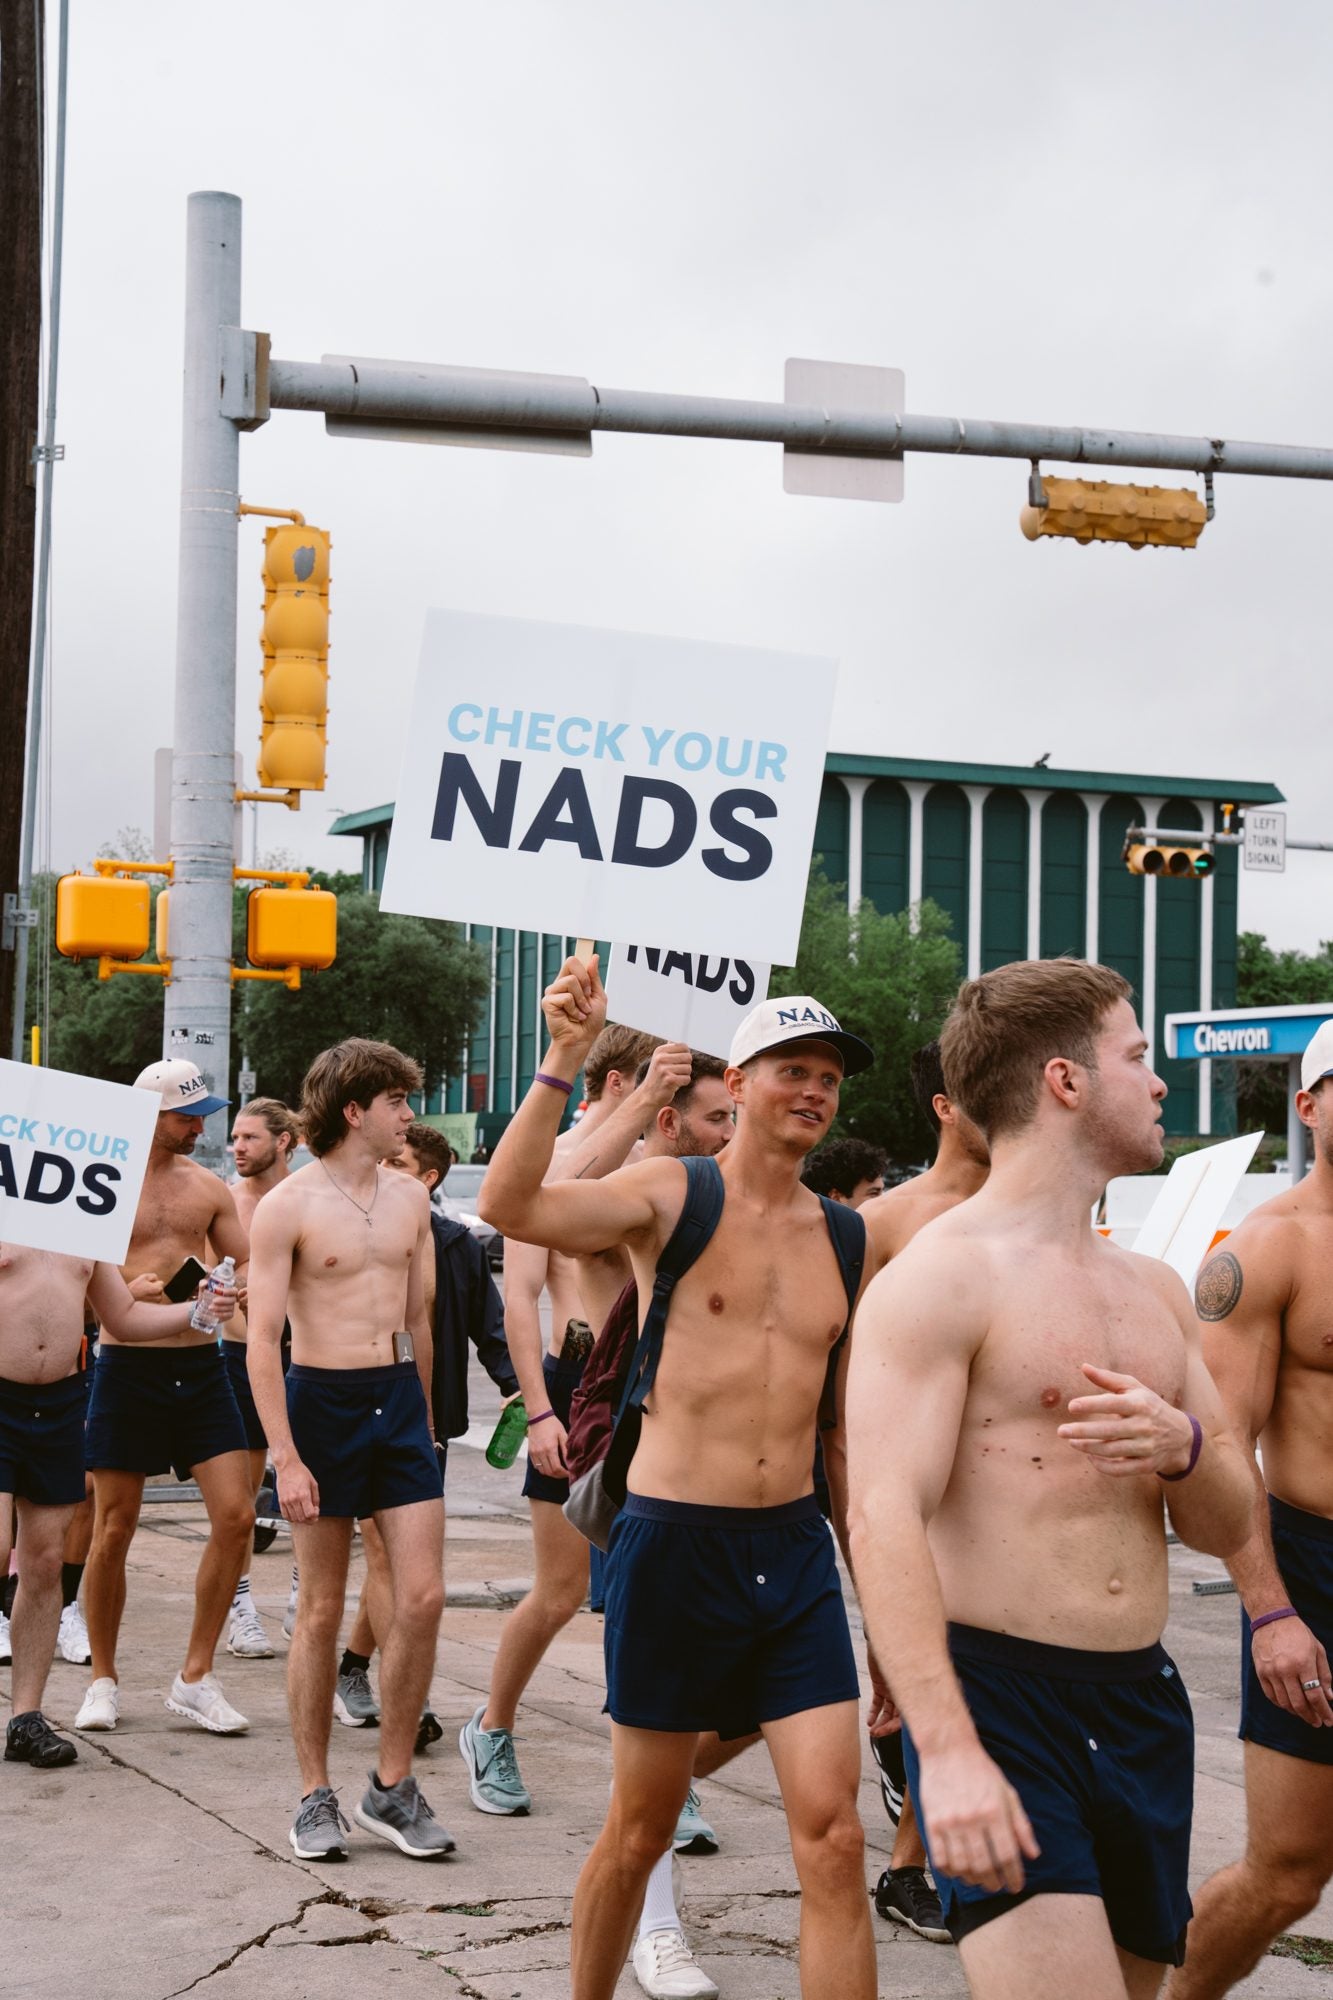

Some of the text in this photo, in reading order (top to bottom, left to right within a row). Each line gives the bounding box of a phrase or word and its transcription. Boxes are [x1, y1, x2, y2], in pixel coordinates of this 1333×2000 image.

[448, 703, 788, 782] CHECK YOUR
[430, 752, 778, 881] NADS
[1253, 817, 1277, 829] LEFT
[1252, 834, 1278, 847] TURN
[1248, 852, 1281, 866] SIGNAL
[1193, 1024, 1269, 1053] Chevron
[46, 1122, 130, 1162] YOUR
